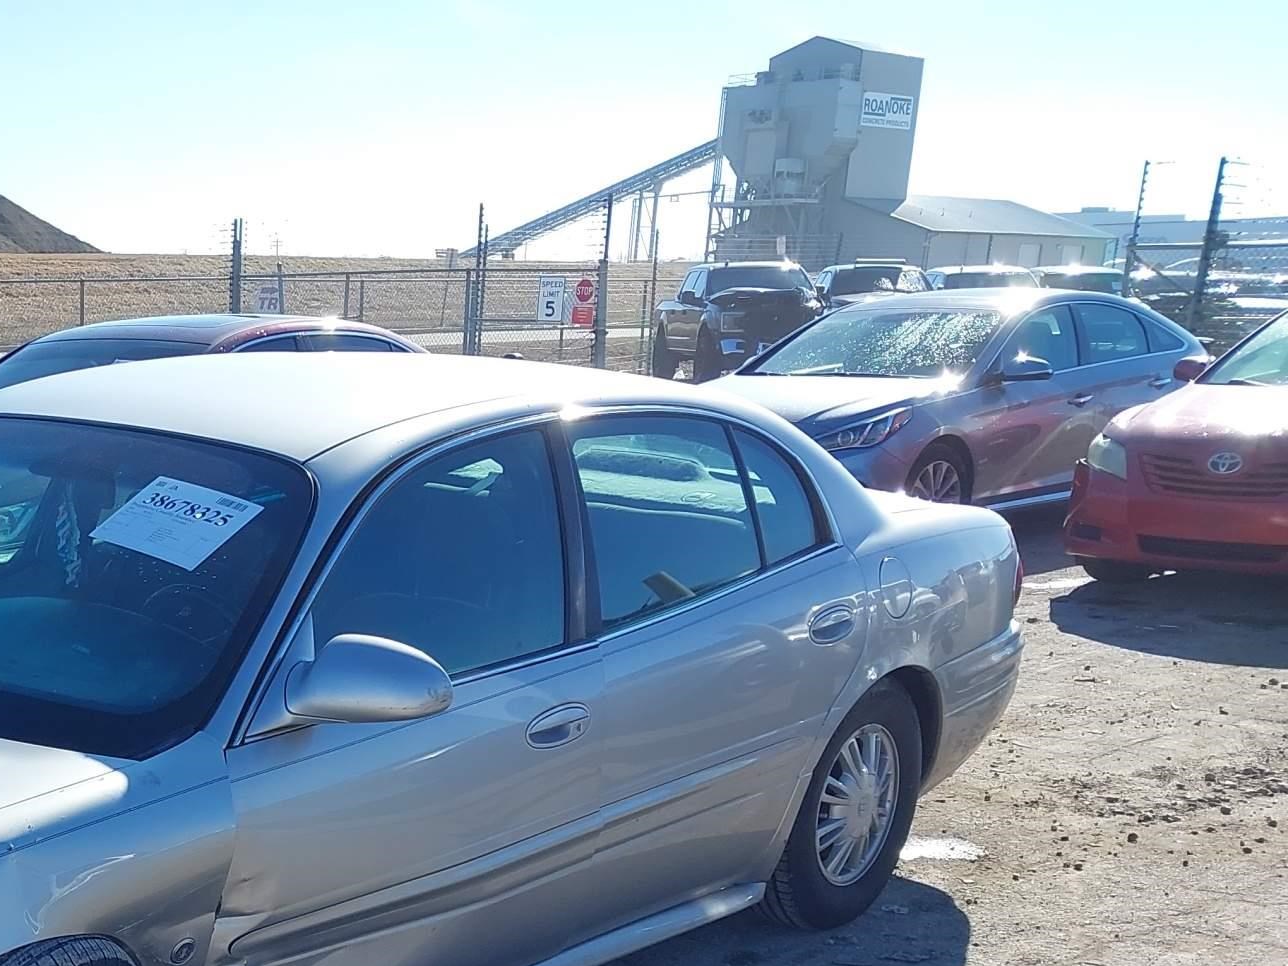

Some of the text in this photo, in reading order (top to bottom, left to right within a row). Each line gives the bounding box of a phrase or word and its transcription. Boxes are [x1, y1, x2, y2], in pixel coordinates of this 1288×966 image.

[864, 97, 912, 116] ROANOKE
[577, 286, 593, 296] STOP
[545, 301, 555, 317] 5
[143, 492, 234, 526] 38678325
